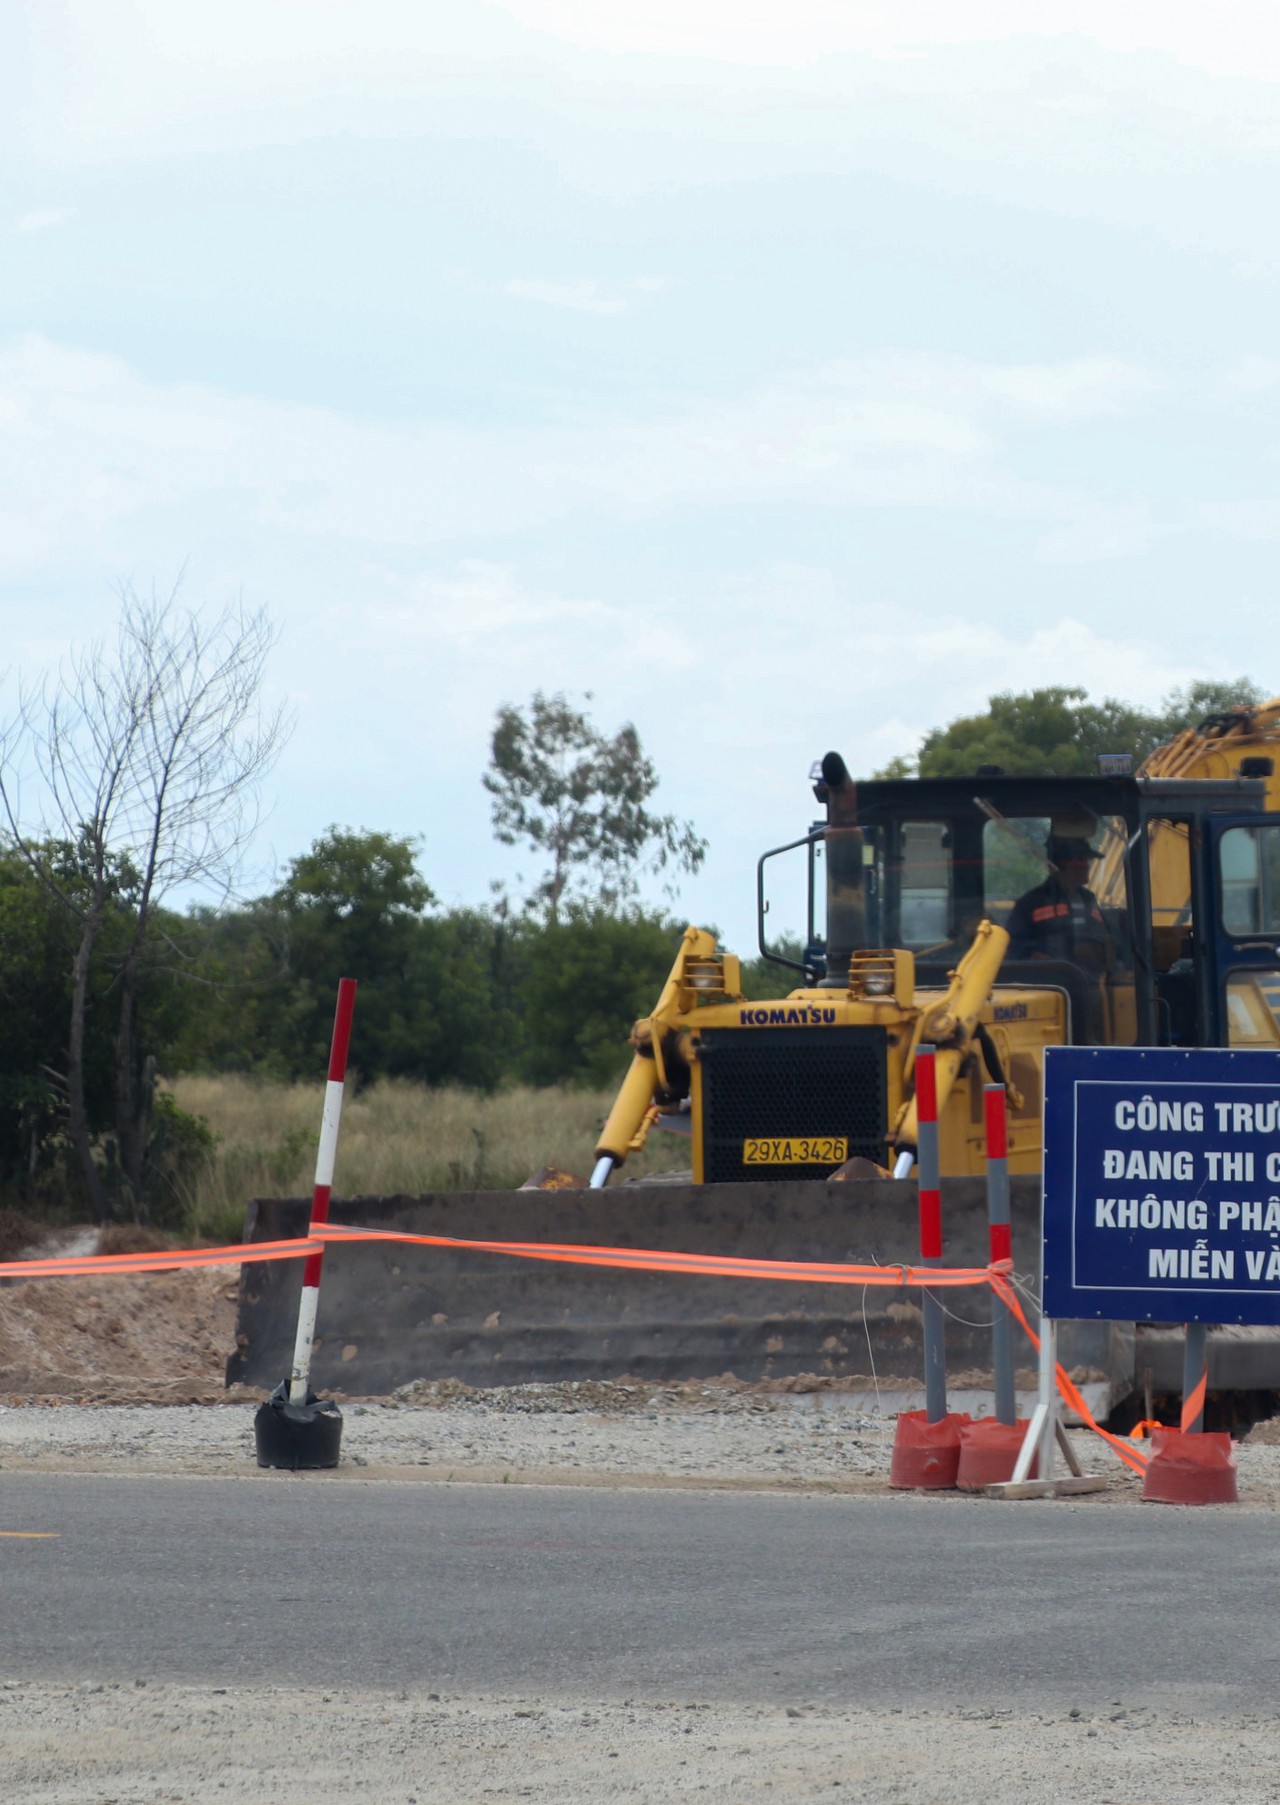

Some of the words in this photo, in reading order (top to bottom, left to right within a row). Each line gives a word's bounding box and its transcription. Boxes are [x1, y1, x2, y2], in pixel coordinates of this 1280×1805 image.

[740, 1004, 836, 1024] KOMATSU
[1115, 1095, 1204, 1132] CÔNG
[747, 1140, 845, 1161] 29XA-3426
[1103, 1150, 1194, 1181] ĐANG
[1204, 1152, 1254, 1182] THI
[1095, 1193, 1208, 1230] KHÔNG
[1148, 1239, 1235, 1279] MIỄN
